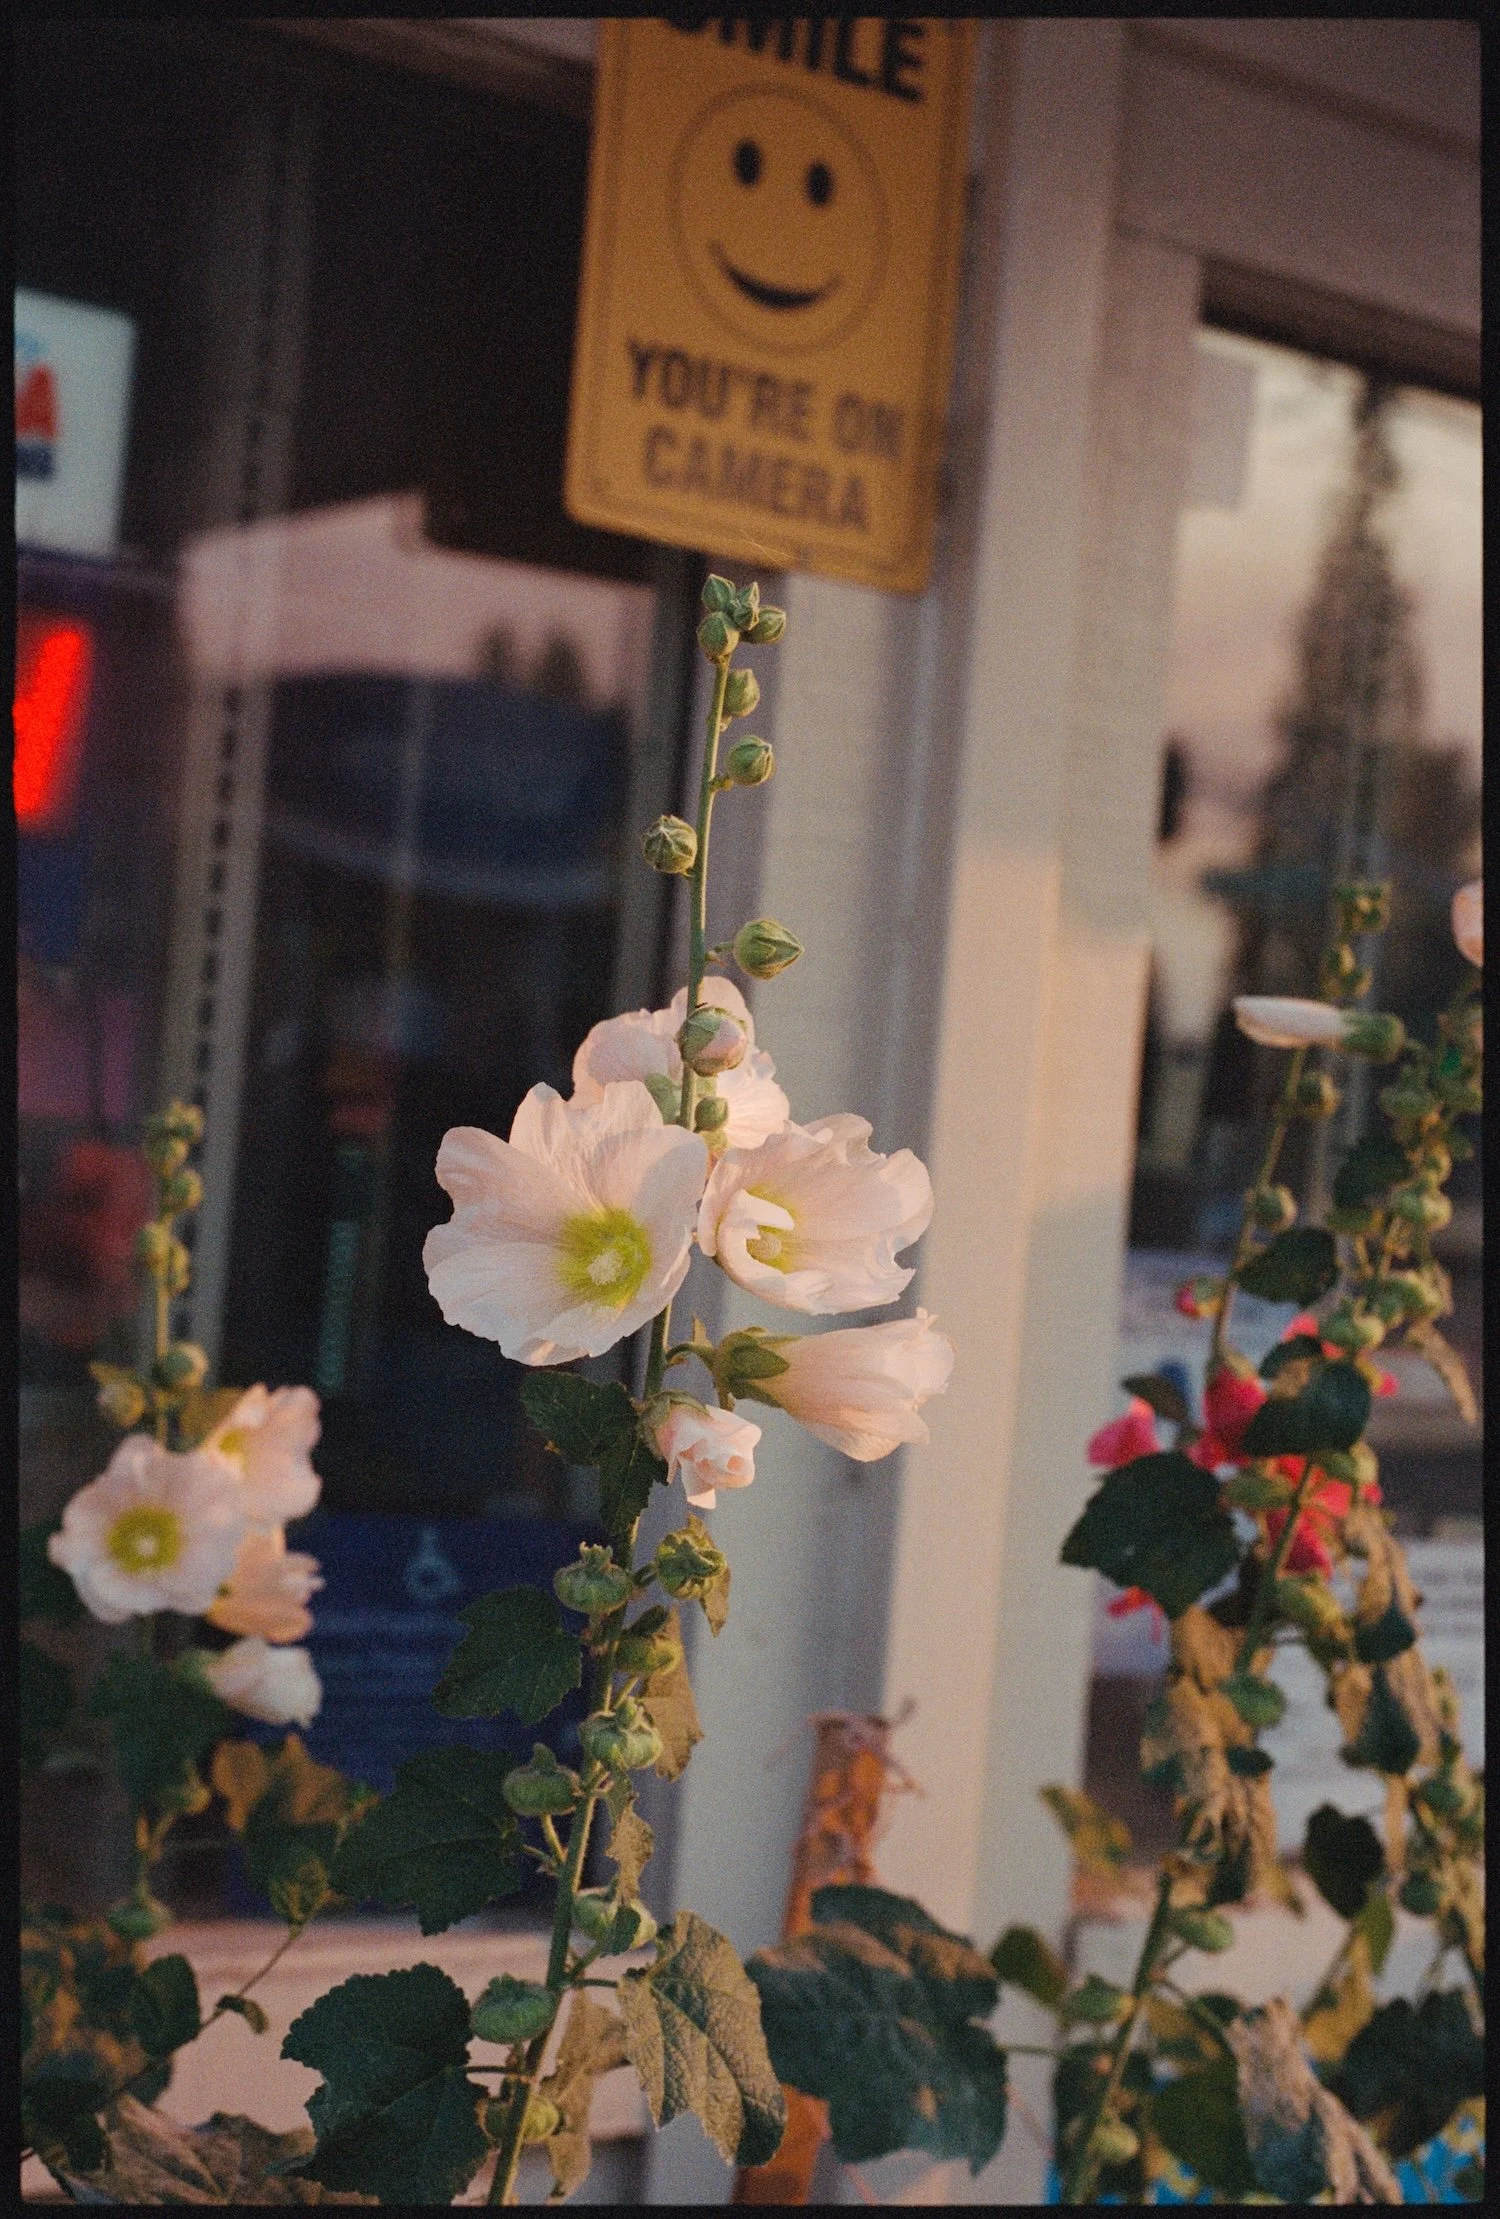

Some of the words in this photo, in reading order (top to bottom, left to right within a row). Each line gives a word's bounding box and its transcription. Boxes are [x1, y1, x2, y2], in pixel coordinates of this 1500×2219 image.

[665, 17, 926, 104] ILE
[626, 339, 813, 443] YOU'RE
[833, 393, 903, 463] ON
[643, 425, 869, 533] CAMERA
